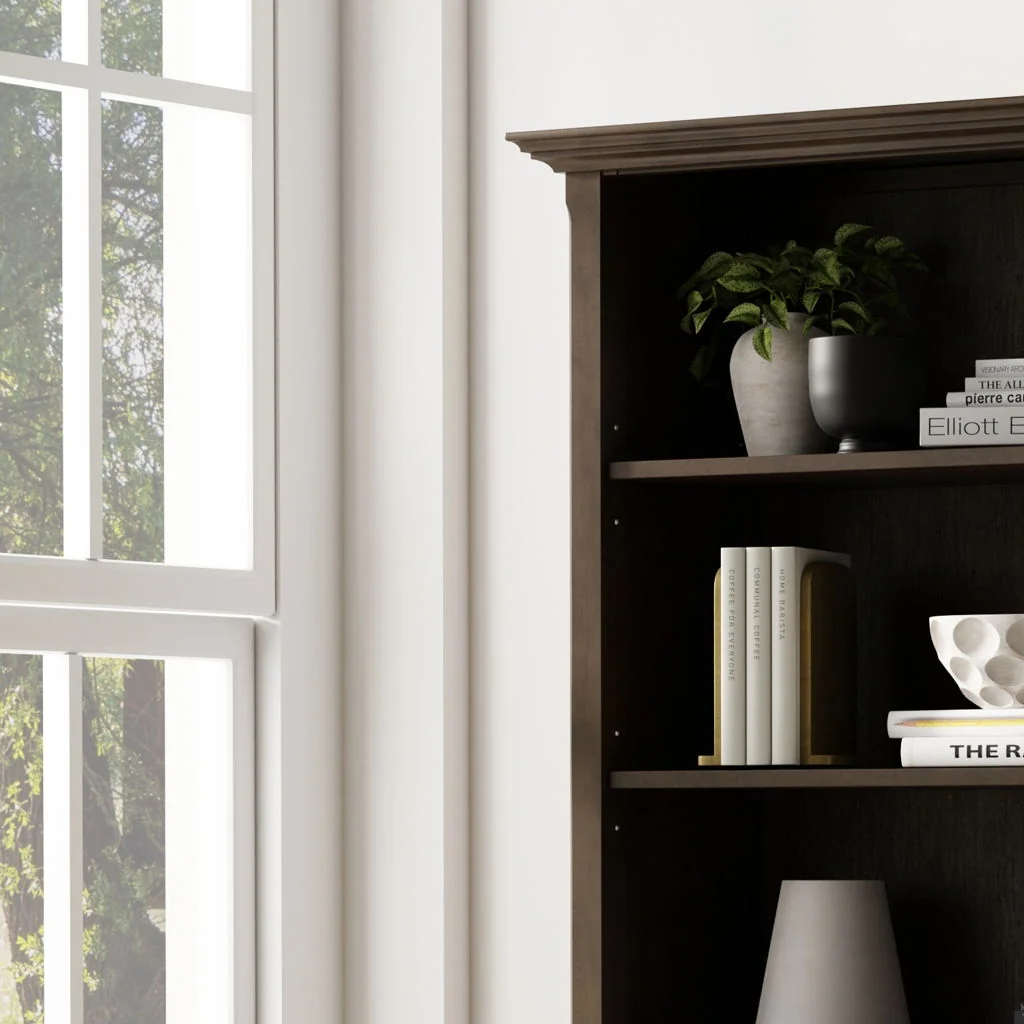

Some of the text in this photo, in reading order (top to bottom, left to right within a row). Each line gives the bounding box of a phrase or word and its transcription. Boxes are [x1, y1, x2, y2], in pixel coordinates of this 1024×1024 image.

[978, 380, 1001, 390] THE
[965, 392, 1003, 406] pierre
[928, 416, 999, 436] Elliott
[753, 567, 761, 661] COMMUNAL COFFEE
[778, 599, 786, 640] BARISTA
[728, 568, 736, 681] COFFEE FOR EVERYONE
[949, 744, 999, 759] THE
